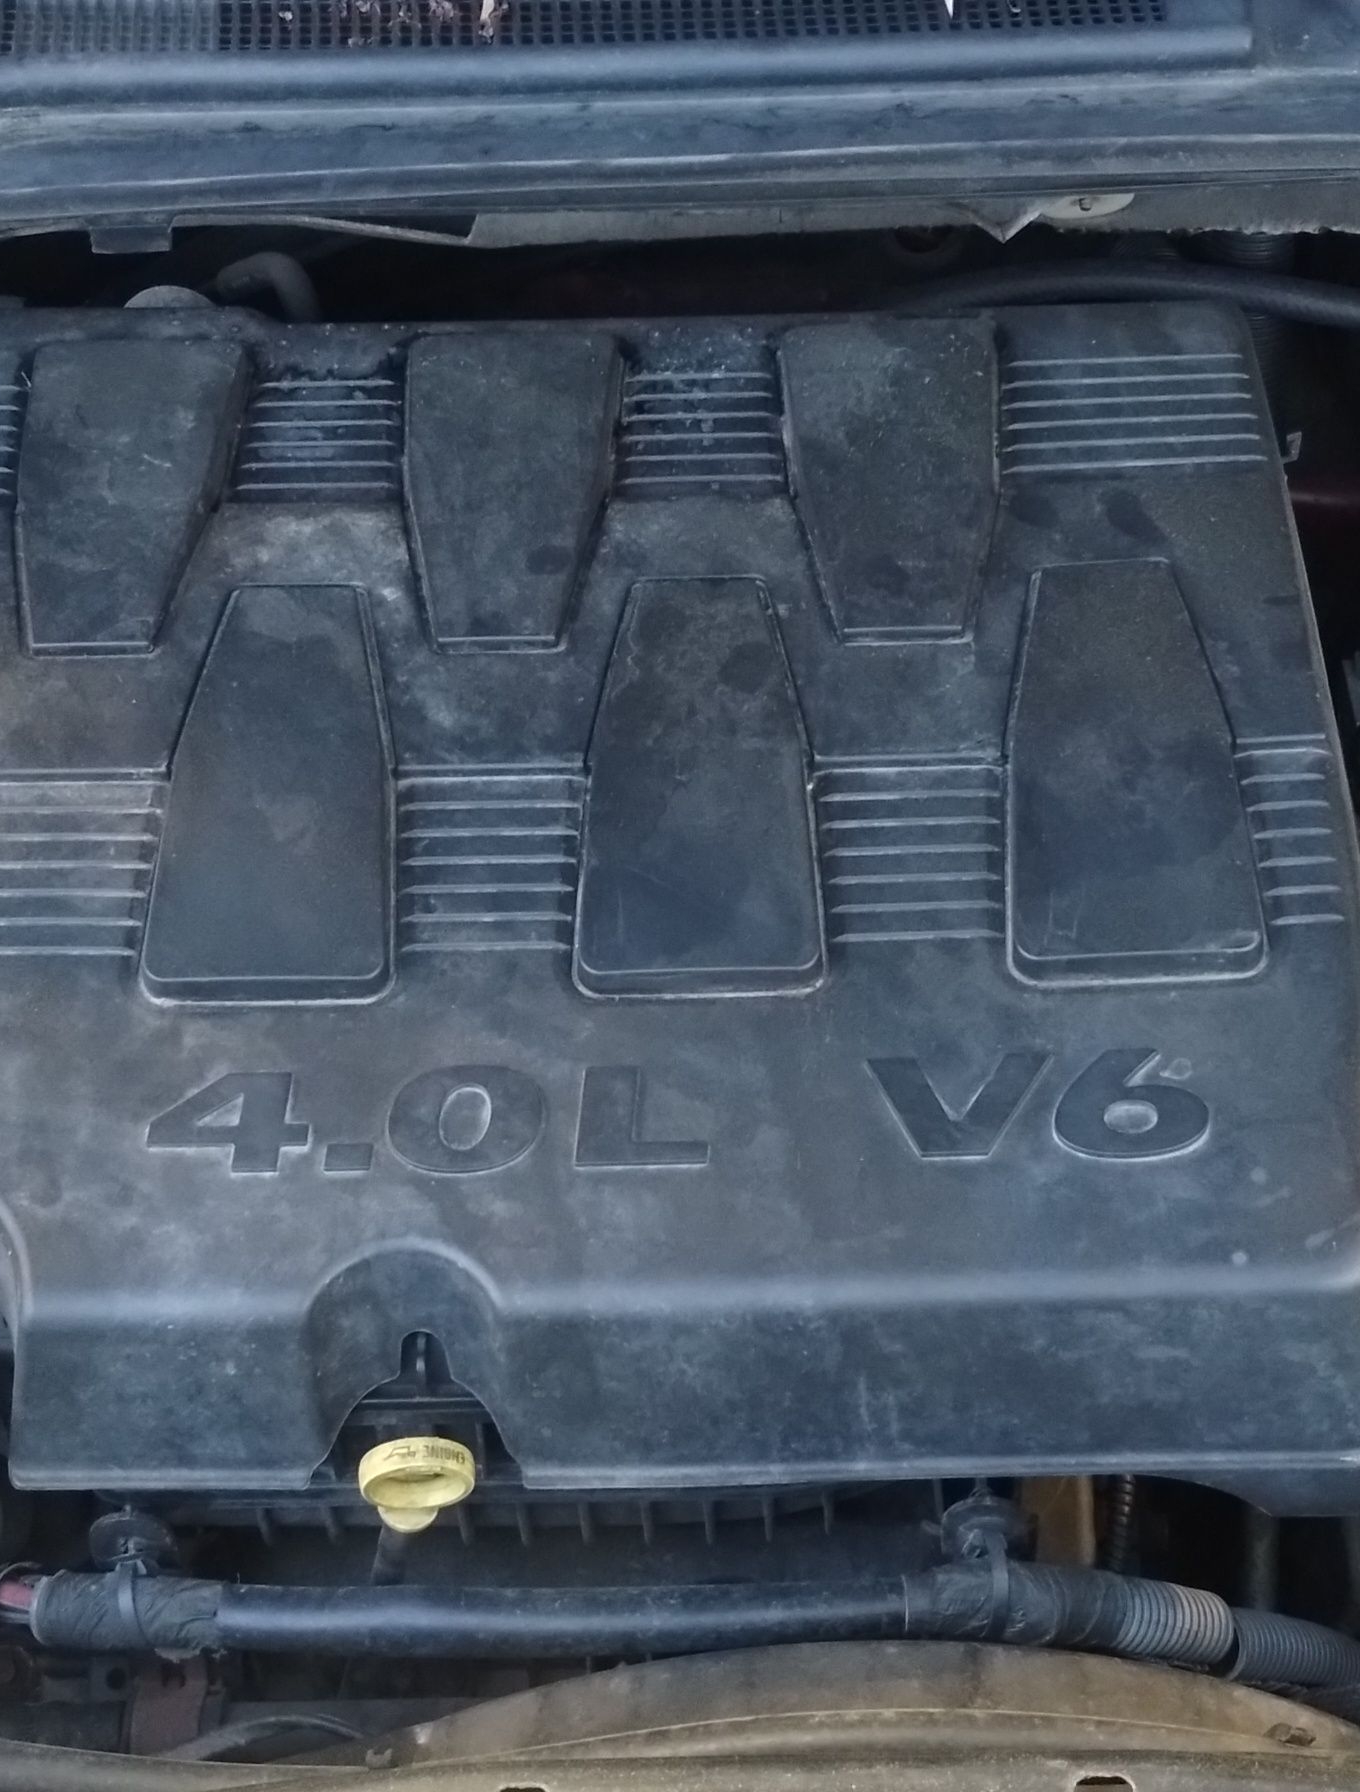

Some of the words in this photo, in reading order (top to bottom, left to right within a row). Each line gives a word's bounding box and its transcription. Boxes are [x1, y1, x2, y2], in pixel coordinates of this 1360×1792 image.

[144, 1063, 711, 1175] 4.0L
[865, 1046, 1211, 1160] V6
[422, 1444, 465, 1465] ENGINE
